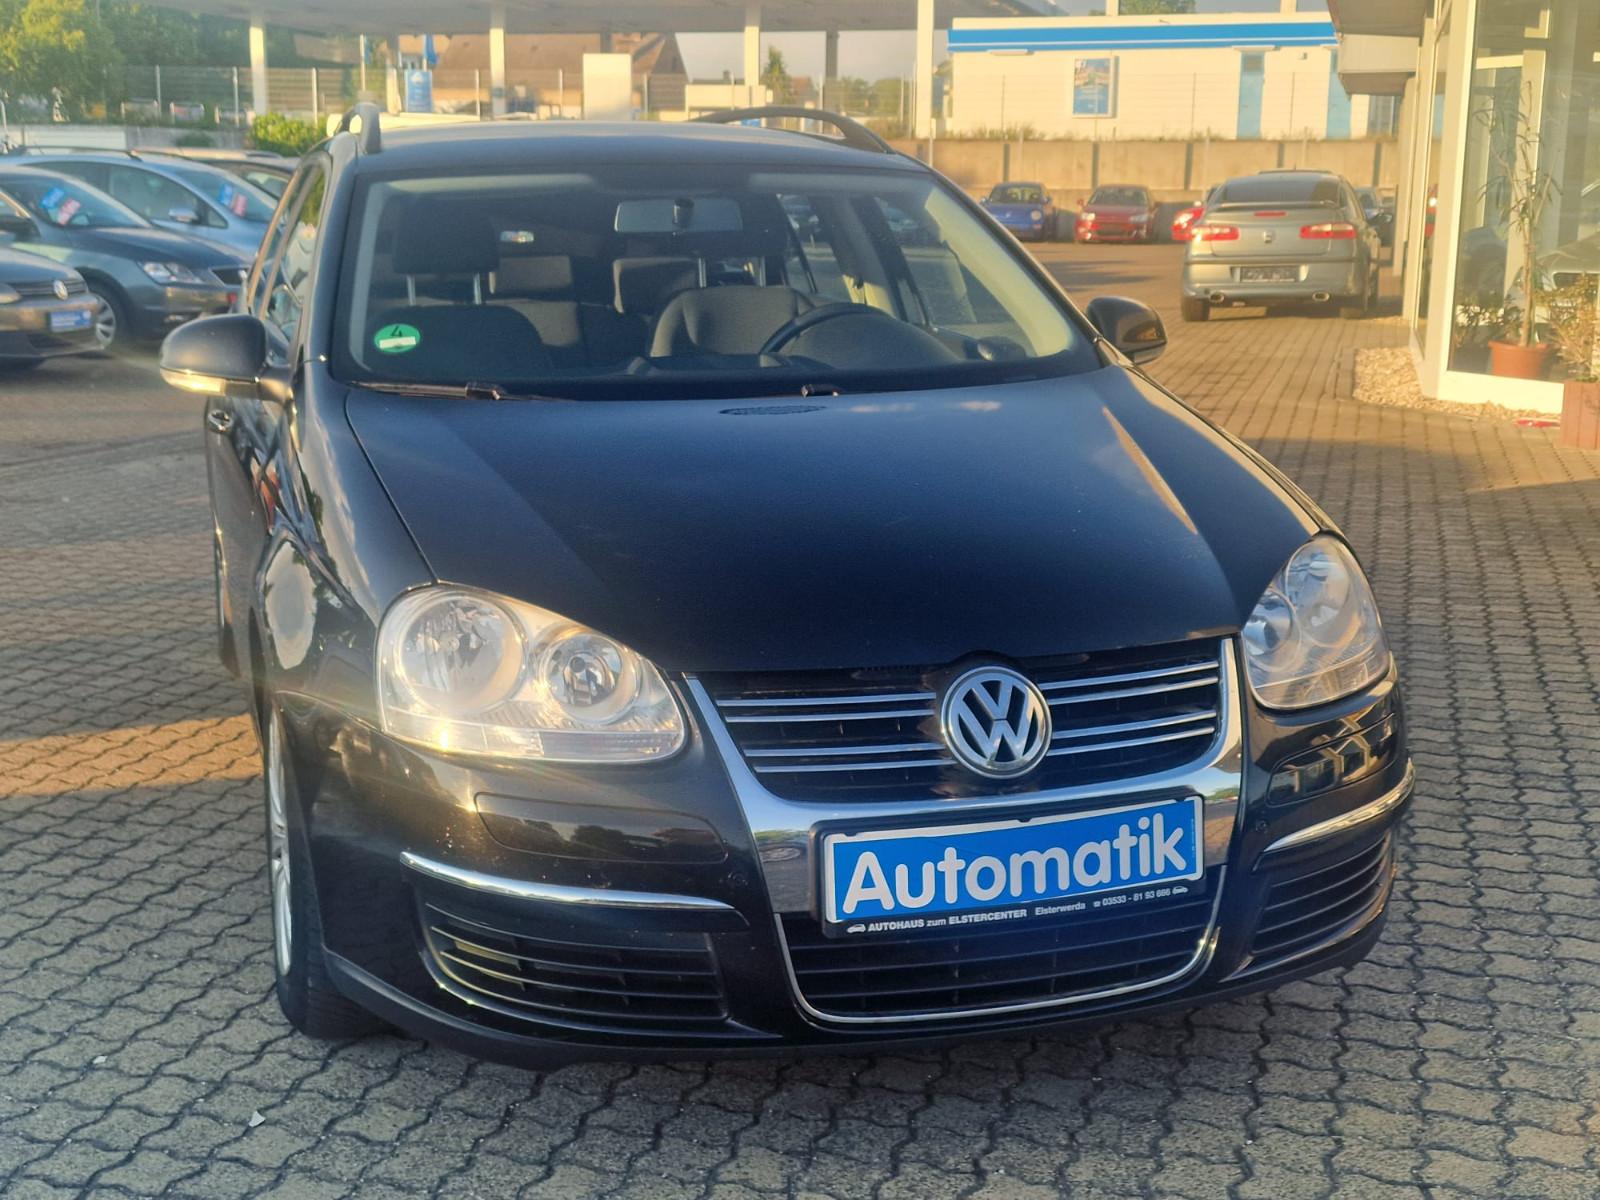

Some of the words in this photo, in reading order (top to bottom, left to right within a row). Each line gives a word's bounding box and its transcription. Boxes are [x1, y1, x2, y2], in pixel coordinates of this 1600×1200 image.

[390, 325, 403, 338] 4
[949, 671, 1047, 772] VW
[842, 812, 1187, 915] Automatik
[868, 918, 924, 932] AUTOHAUS
[926, 917, 947, 928] zum
[949, 909, 1027, 925] ELSTERCENTER
[1035, 902, 1086, 916] Elsterwerda
[1102, 895, 1127, 906] 03533
